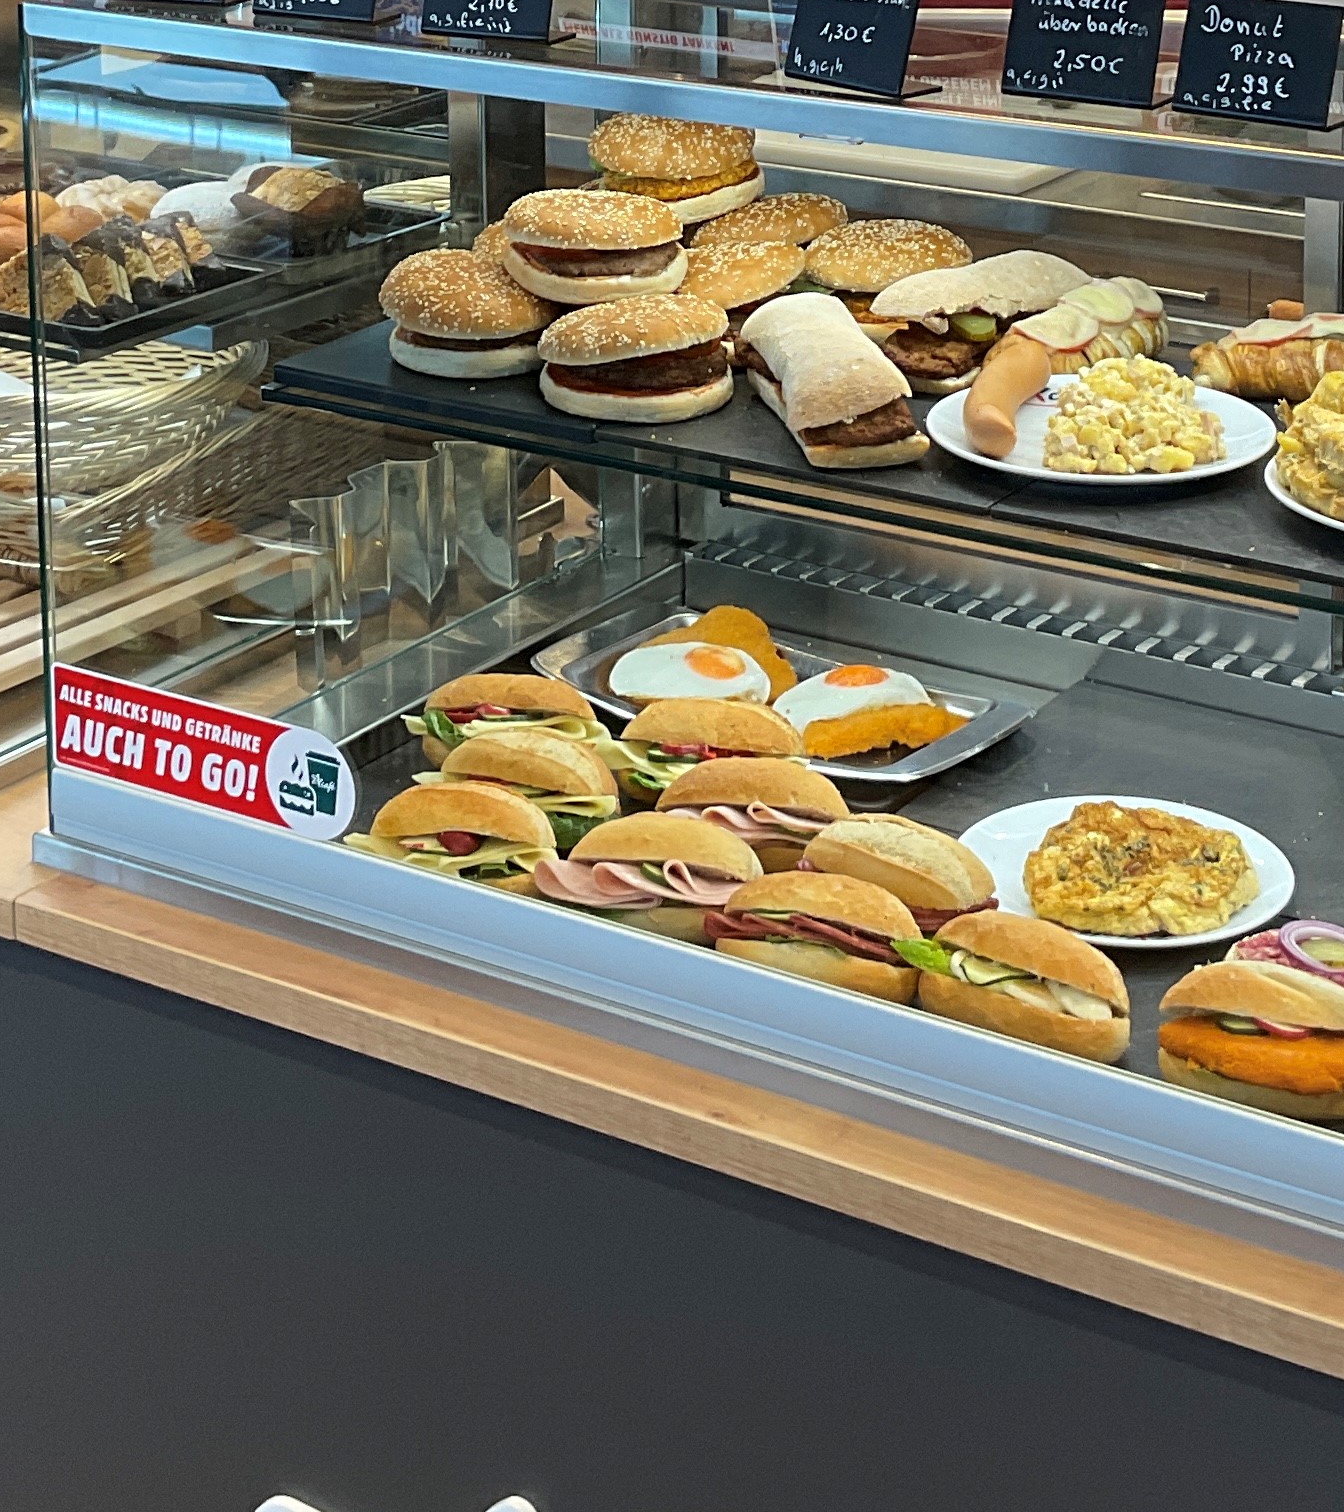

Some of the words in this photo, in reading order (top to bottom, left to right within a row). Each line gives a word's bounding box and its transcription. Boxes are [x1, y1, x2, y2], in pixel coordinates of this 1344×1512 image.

[1038, 10, 1149, 37] überbacken
[1201, 4, 1284, 38] Donut
[1230, 42, 1294, 69] Pizza
[60, 685, 92, 707] ALLE
[94, 693, 149, 722] SNACKS
[152, 709, 182, 731] UND
[185, 718, 261, 753] GETRÄNKE
[61, 714, 146, 770] AUCH
[154, 738, 192, 782] TO
[201, 753, 259, 802] GO!
